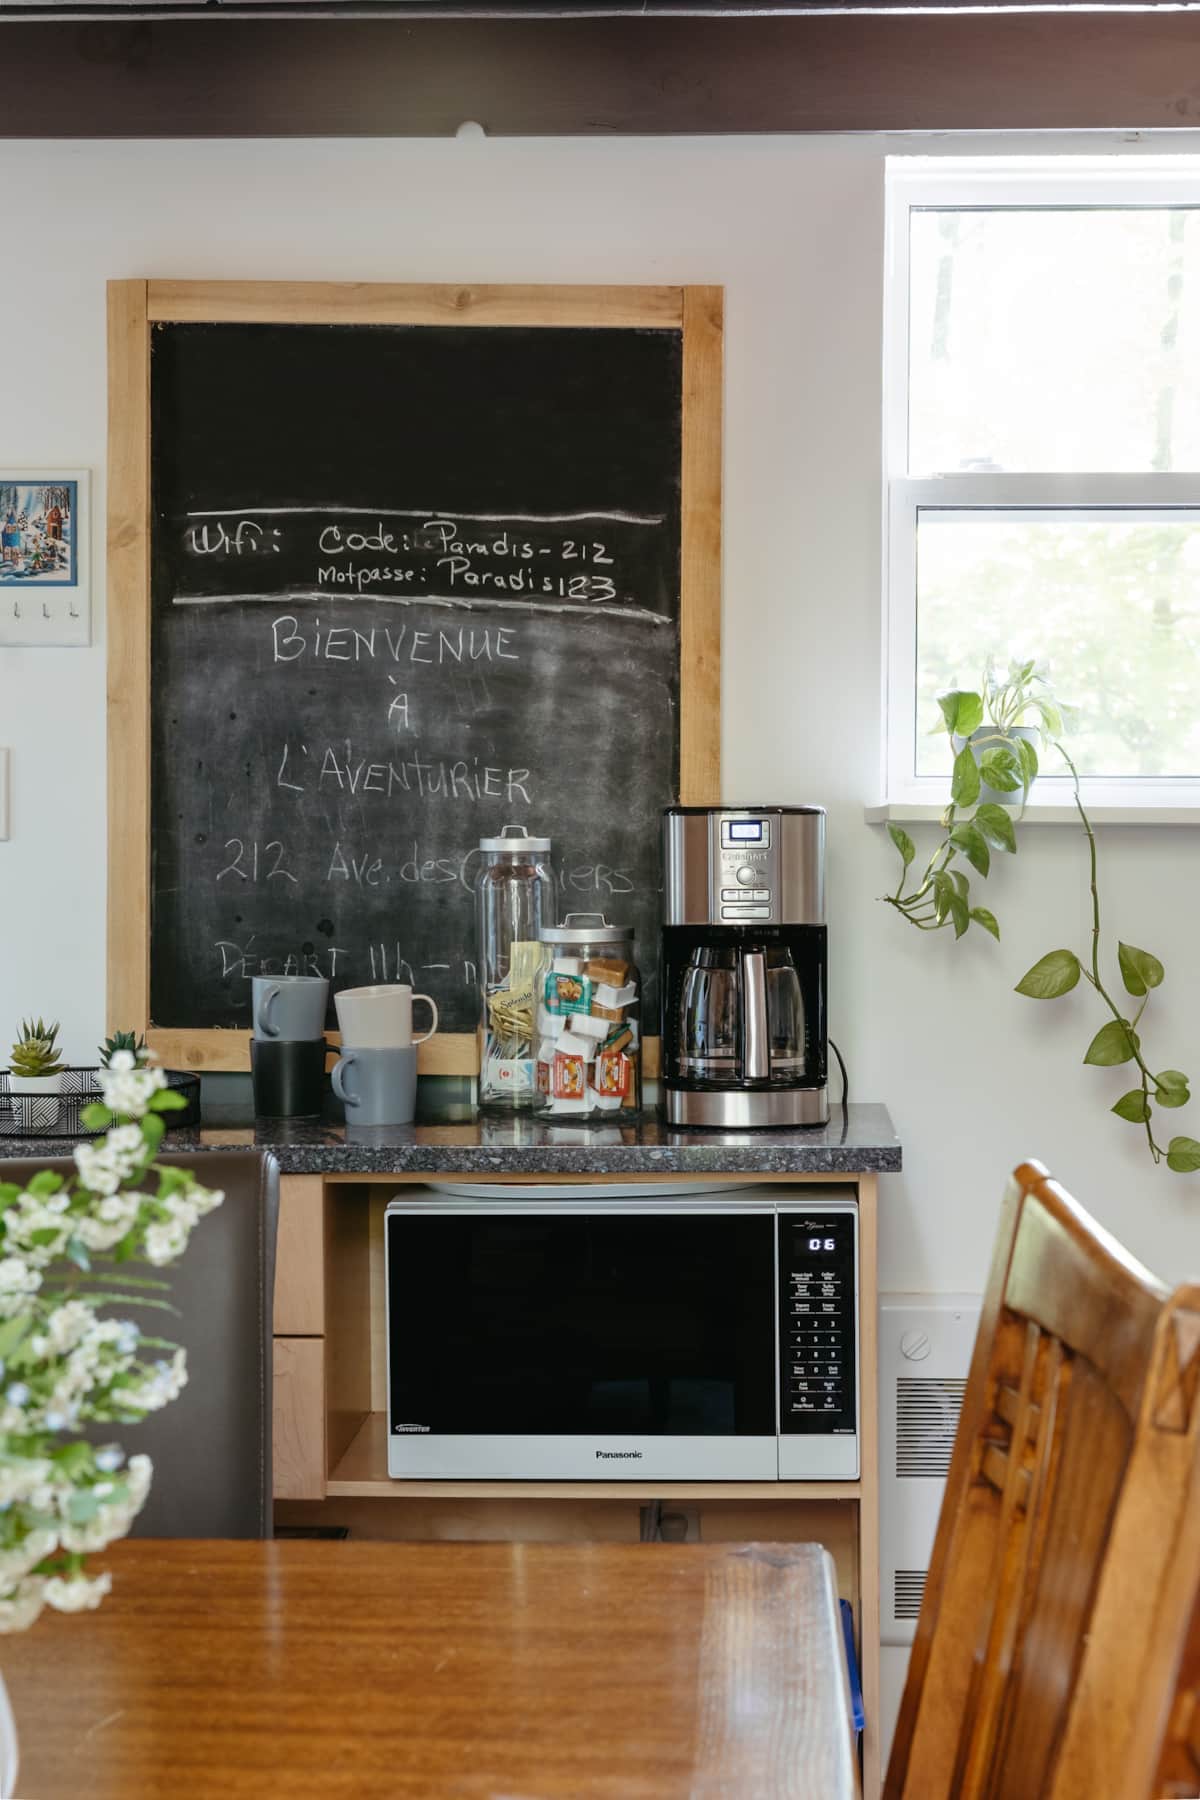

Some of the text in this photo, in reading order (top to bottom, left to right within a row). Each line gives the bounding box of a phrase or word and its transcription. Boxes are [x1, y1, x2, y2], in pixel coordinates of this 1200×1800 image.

[319, 522, 410, 553] Code:
[436, 556, 616, 601] Paradis123
[216, 838, 298, 882] 212
[400, 840, 457, 882] des
[596, 1450, 643, 1459] Panasonic
